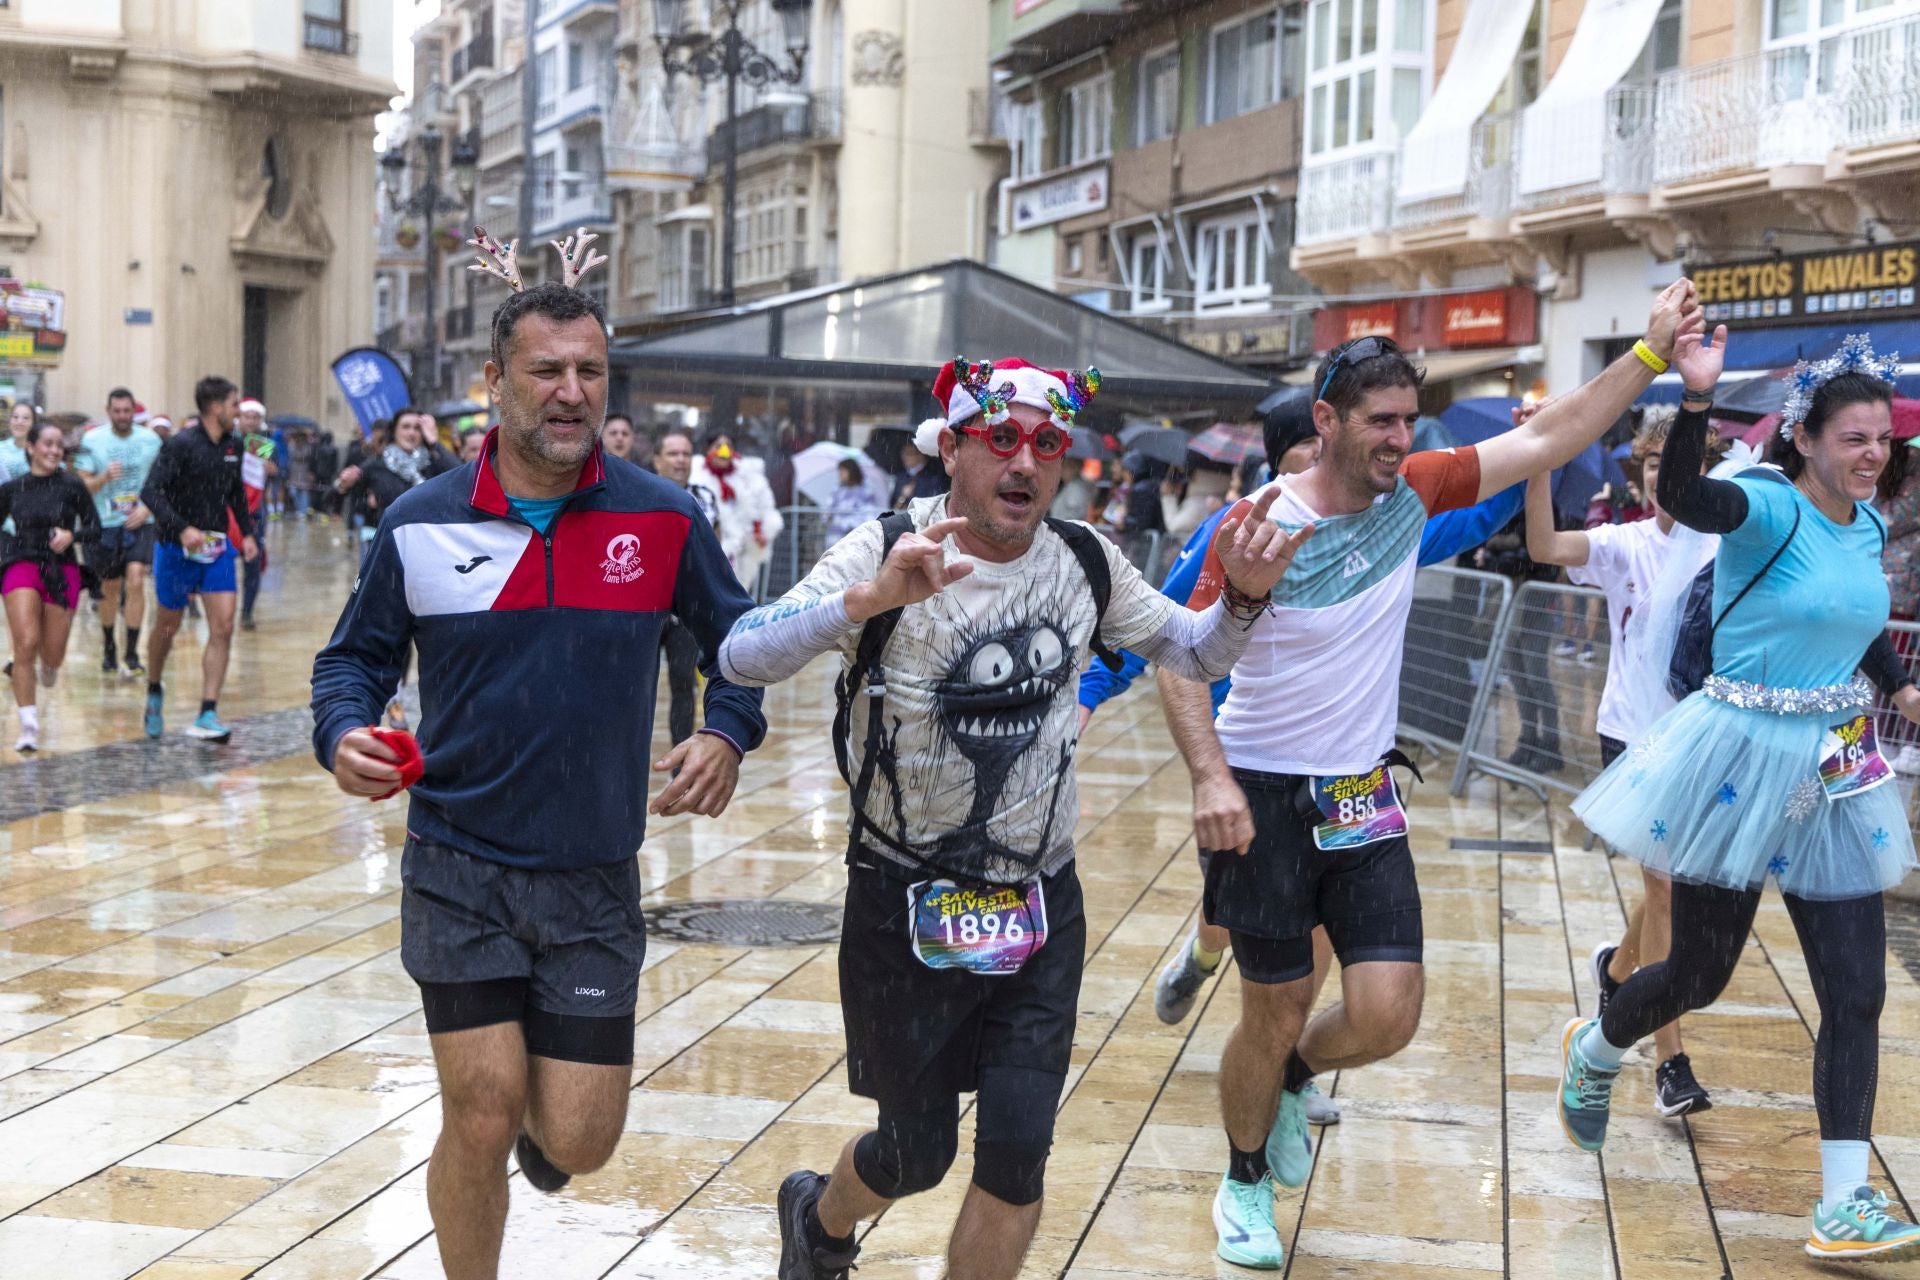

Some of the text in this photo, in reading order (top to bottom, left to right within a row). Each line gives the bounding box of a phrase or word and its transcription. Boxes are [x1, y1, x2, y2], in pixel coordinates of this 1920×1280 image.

[1693, 247, 1916, 303] EFECTOS NAVALES
[602, 570, 620, 584] Torre
[1835, 741, 1866, 773] 195
[1334, 775, 1358, 790] SAN
[1338, 794, 1377, 824] 858
[941, 890, 976, 905] SAN
[941, 889, 1017, 916] SILVESTR
[940, 912, 1024, 945] 1896
[575, 986, 605, 997] LIXADA
